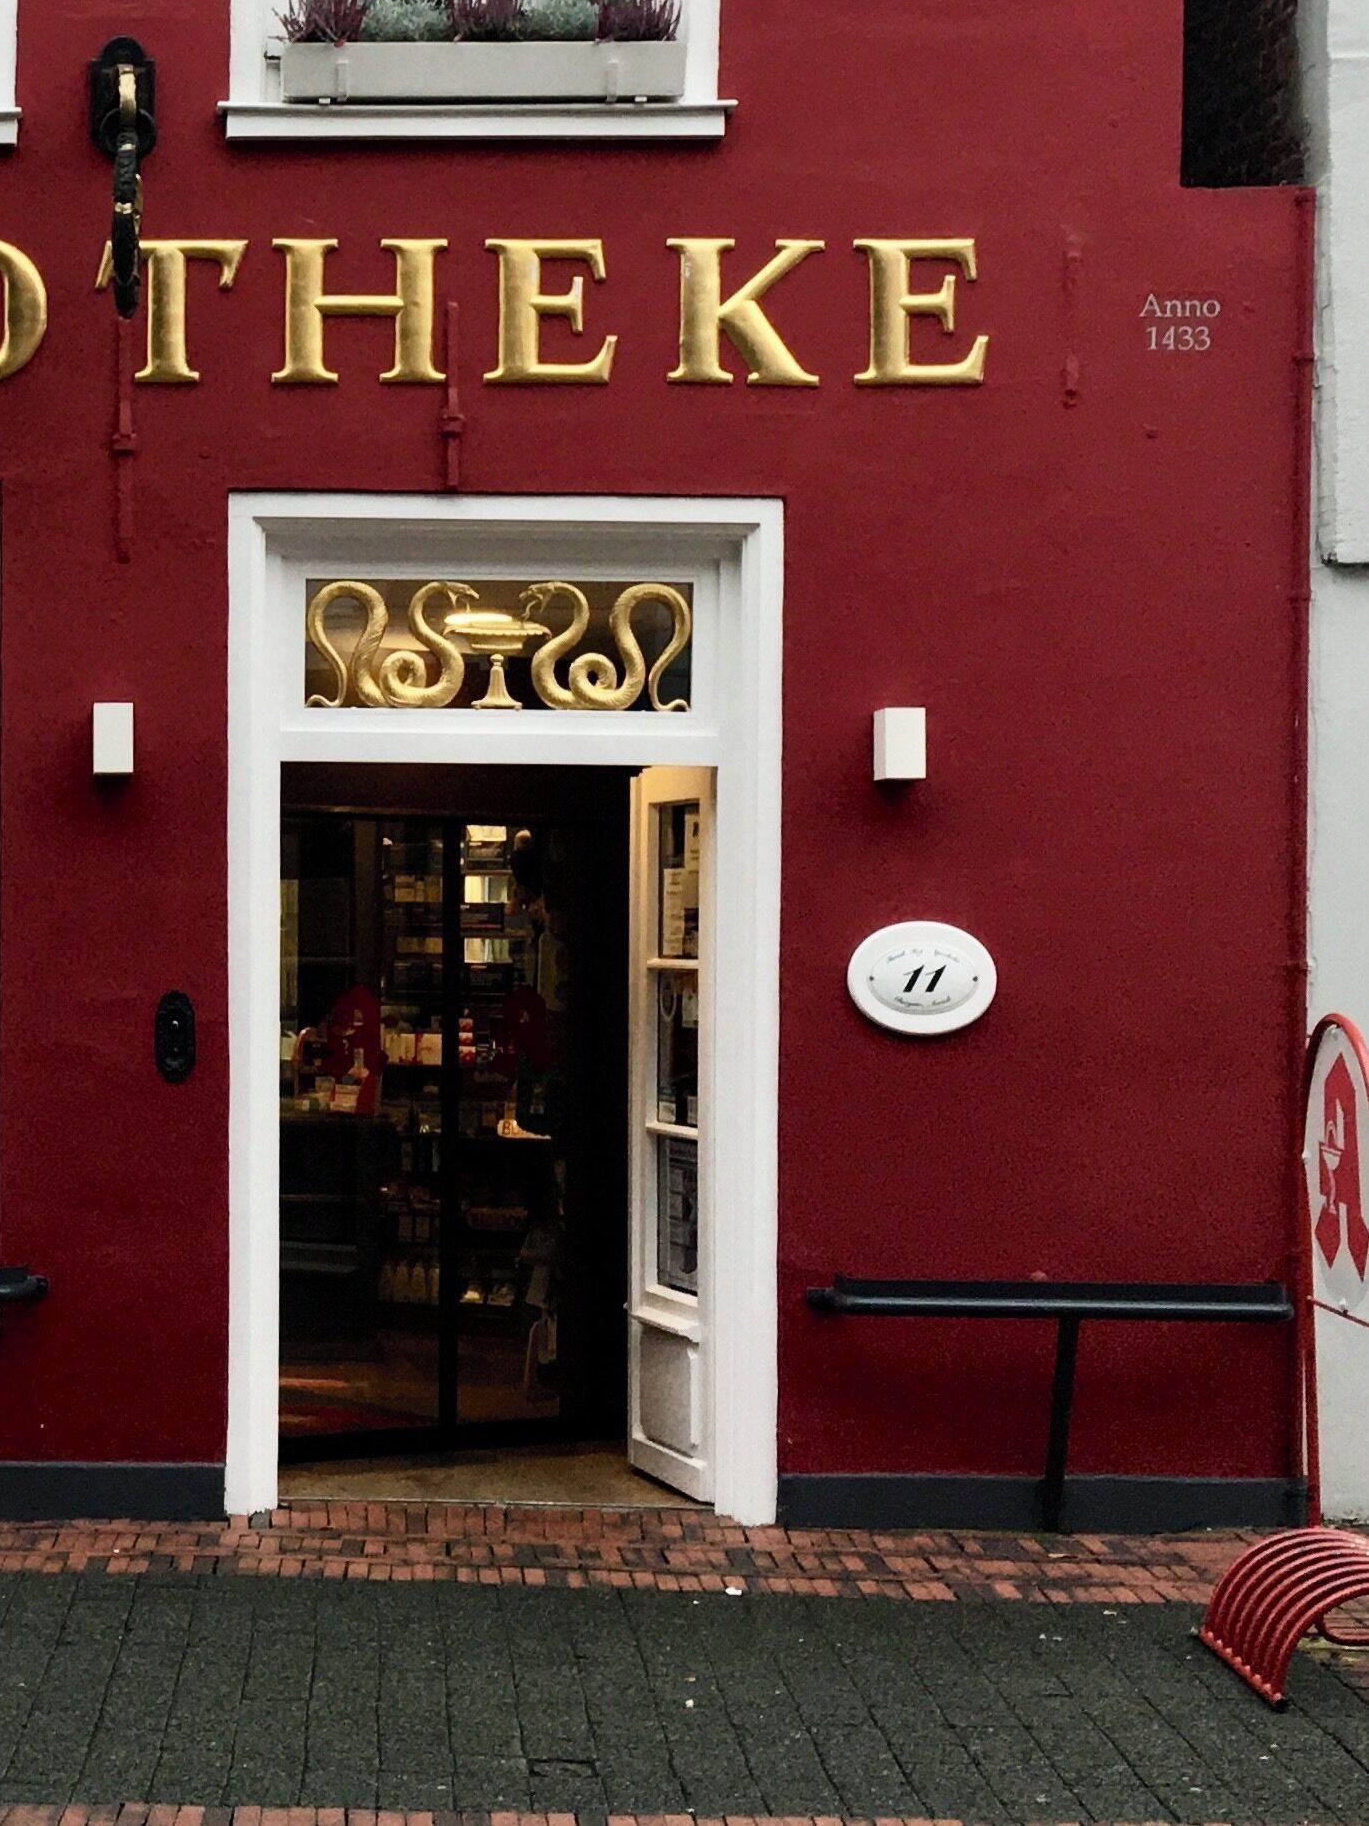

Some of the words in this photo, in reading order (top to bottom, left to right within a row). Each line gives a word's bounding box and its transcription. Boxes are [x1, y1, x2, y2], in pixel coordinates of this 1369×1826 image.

[1139, 294, 1221, 318] Anno
[1146, 326, 1211, 351] 1433
[902, 964, 947, 993] 11
